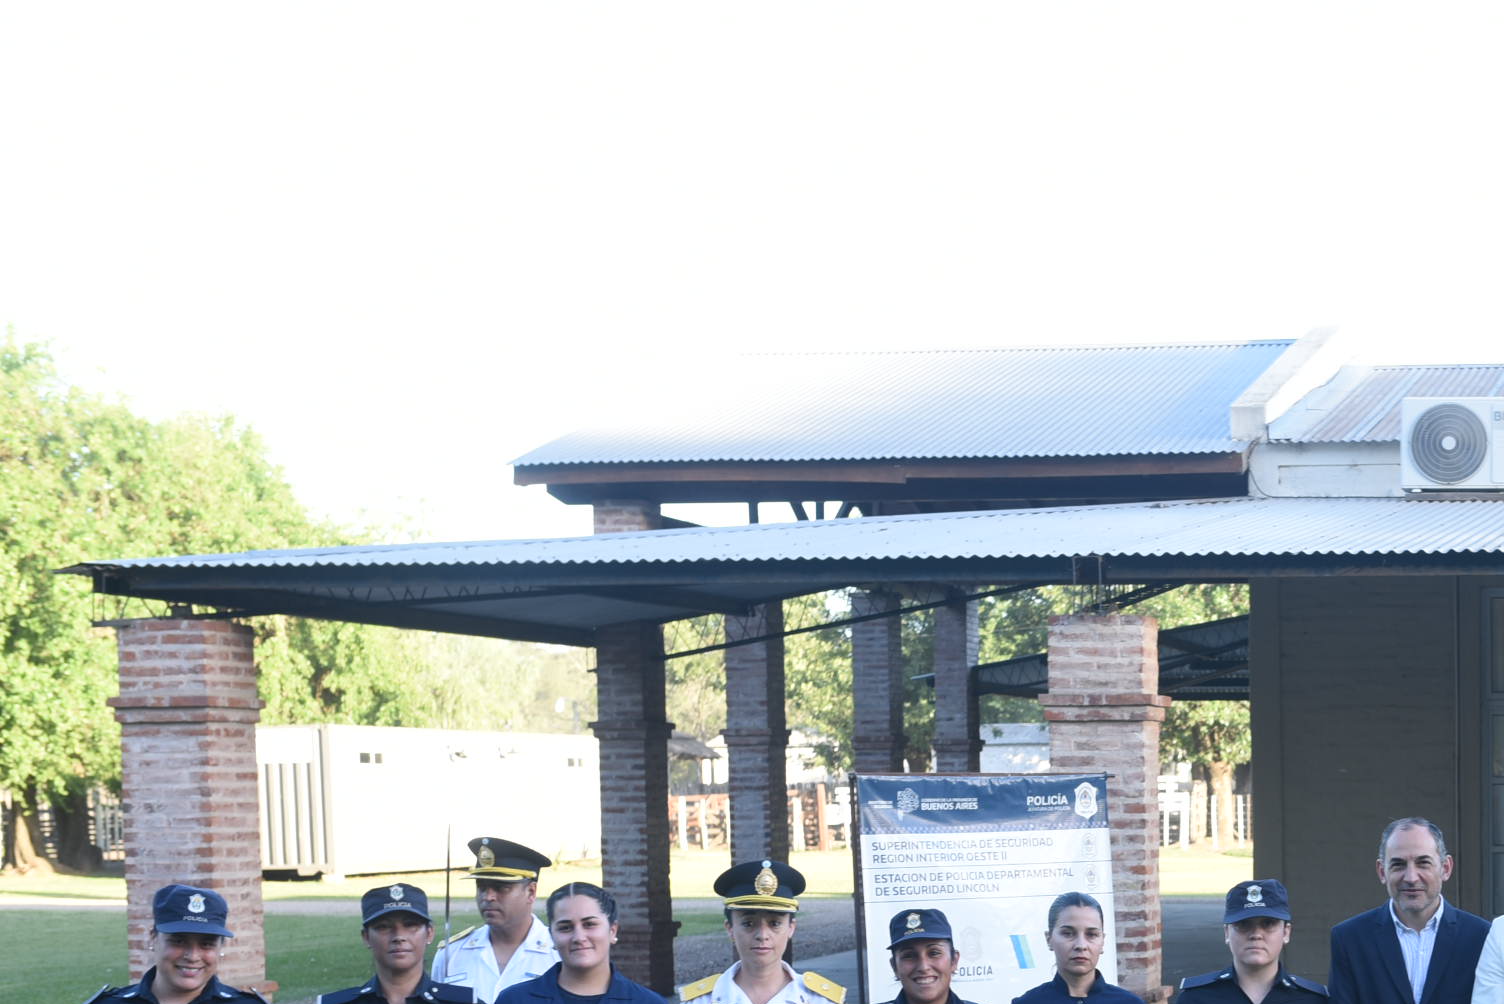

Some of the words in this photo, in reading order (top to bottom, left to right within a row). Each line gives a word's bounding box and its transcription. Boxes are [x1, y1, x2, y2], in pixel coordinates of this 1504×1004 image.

[921, 802, 954, 810] BUENOS
[955, 801, 978, 810] AIRES
[1026, 792, 1069, 806] POLICÍA
[871, 839, 977, 851] SUPERINTENDENCIA
[979, 839, 993, 849] DE
[995, 837, 1054, 848] SEGURIDAD
[872, 853, 913, 864] REGION
[916, 852, 964, 862] INTERIOR
[966, 851, 1000, 861] OESTE
[874, 872, 927, 884] ESTACION
[929, 871, 943, 882] DE
[945, 870, 985, 881] POLICIA
[986, 867, 1075, 880] DEPARTAMENTAL
[875, 887, 890, 897] DE
[892, 885, 954, 896] SEGURIDAD
[957, 883, 1000, 894] LINCOLN
[957, 965, 993, 977] OLICIA
